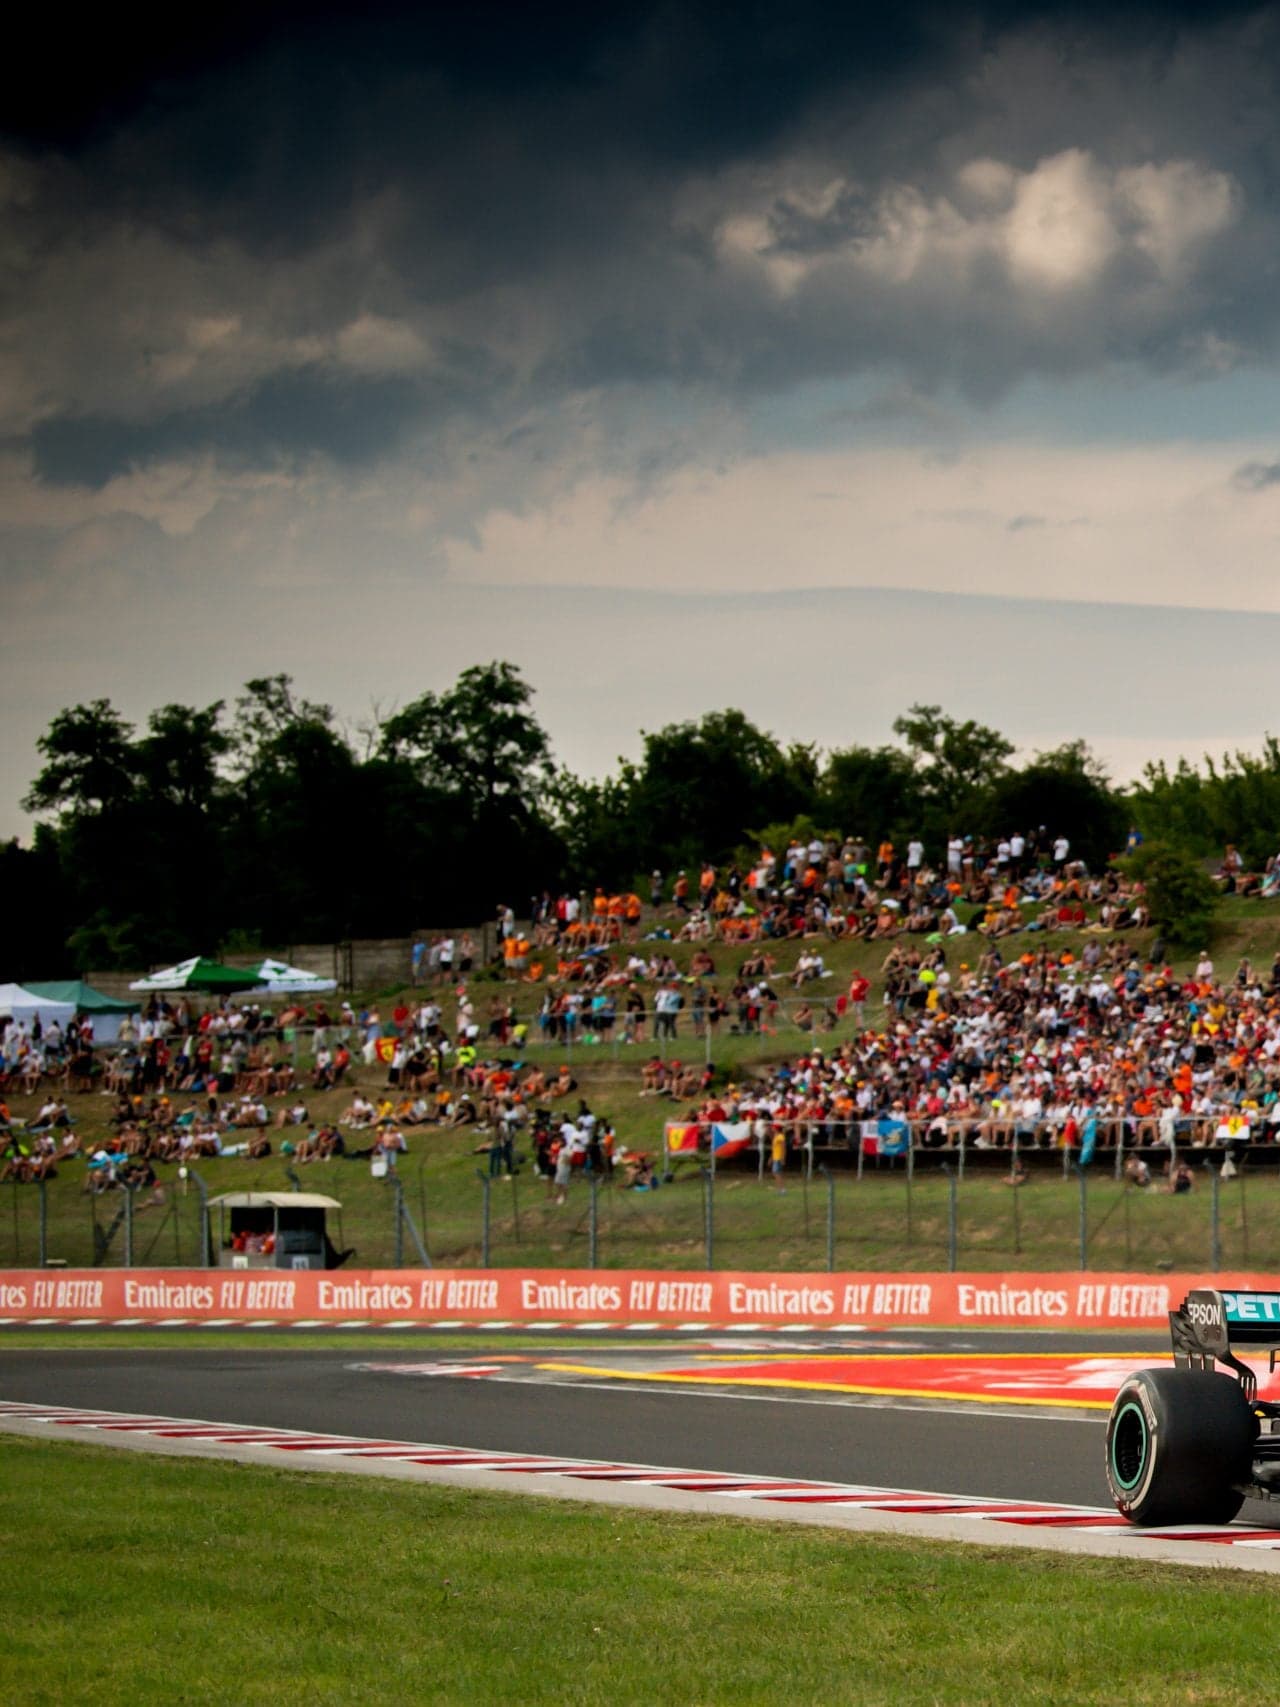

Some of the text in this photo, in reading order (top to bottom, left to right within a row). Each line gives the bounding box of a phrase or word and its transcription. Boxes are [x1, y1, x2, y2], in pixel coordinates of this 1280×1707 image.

[33, 1281, 55, 1308] FLY
[57, 1281, 103, 1308] BETTER
[124, 1280, 296, 1310] Emirates FLY BETTER
[318, 1279, 498, 1311] Emirates FLY BETTER
[522, 1279, 712, 1312] Emirates FLY BETTER
[729, 1283, 932, 1315] Emirates FLY BETTER
[958, 1284, 1170, 1317] Emirates FLY BETTER
[1187, 1303, 1222, 1326] EPSON
